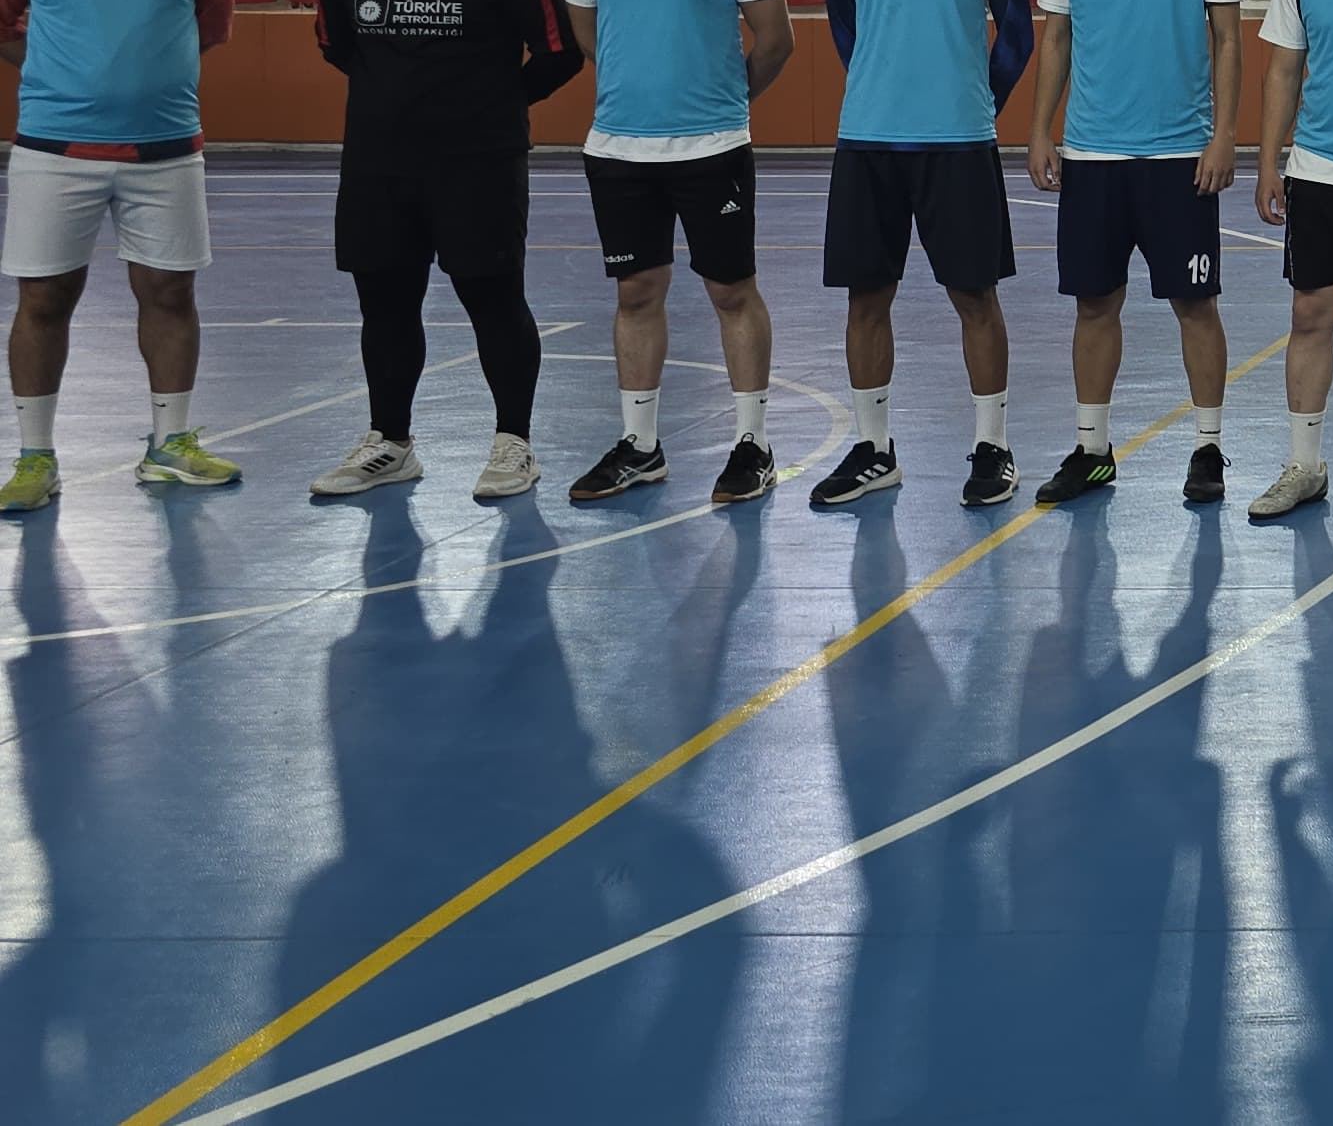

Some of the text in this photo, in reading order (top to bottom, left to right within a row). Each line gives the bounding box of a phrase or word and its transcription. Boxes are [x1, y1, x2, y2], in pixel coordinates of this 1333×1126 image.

[393, 0, 462, 14] TÜRKİYE
[392, 14, 463, 25] PETROLLERİ
[1188, 254, 1210, 284] 19
